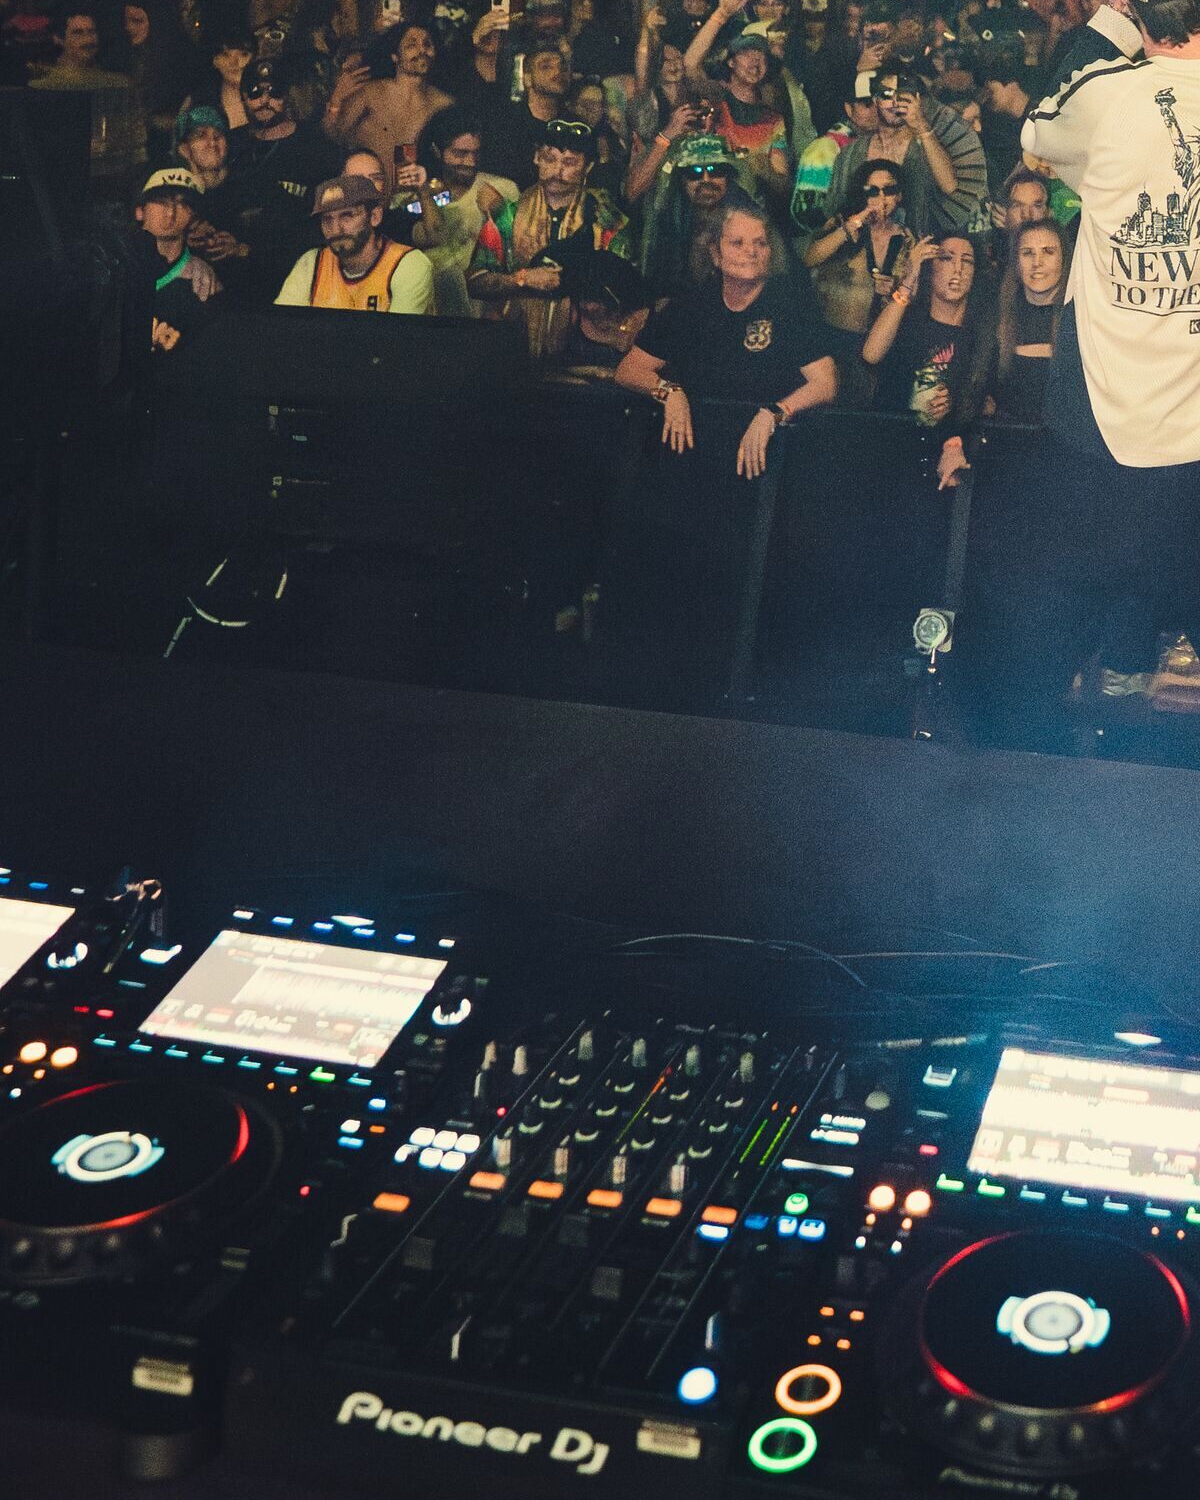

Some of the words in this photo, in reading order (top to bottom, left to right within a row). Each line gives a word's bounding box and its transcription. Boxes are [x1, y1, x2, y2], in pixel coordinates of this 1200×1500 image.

[1108, 245, 1200, 283] NEW
[1111, 281, 1147, 306] TO
[1153, 282, 1200, 310] THE
[336, 1390, 542, 1454] Pioneer
